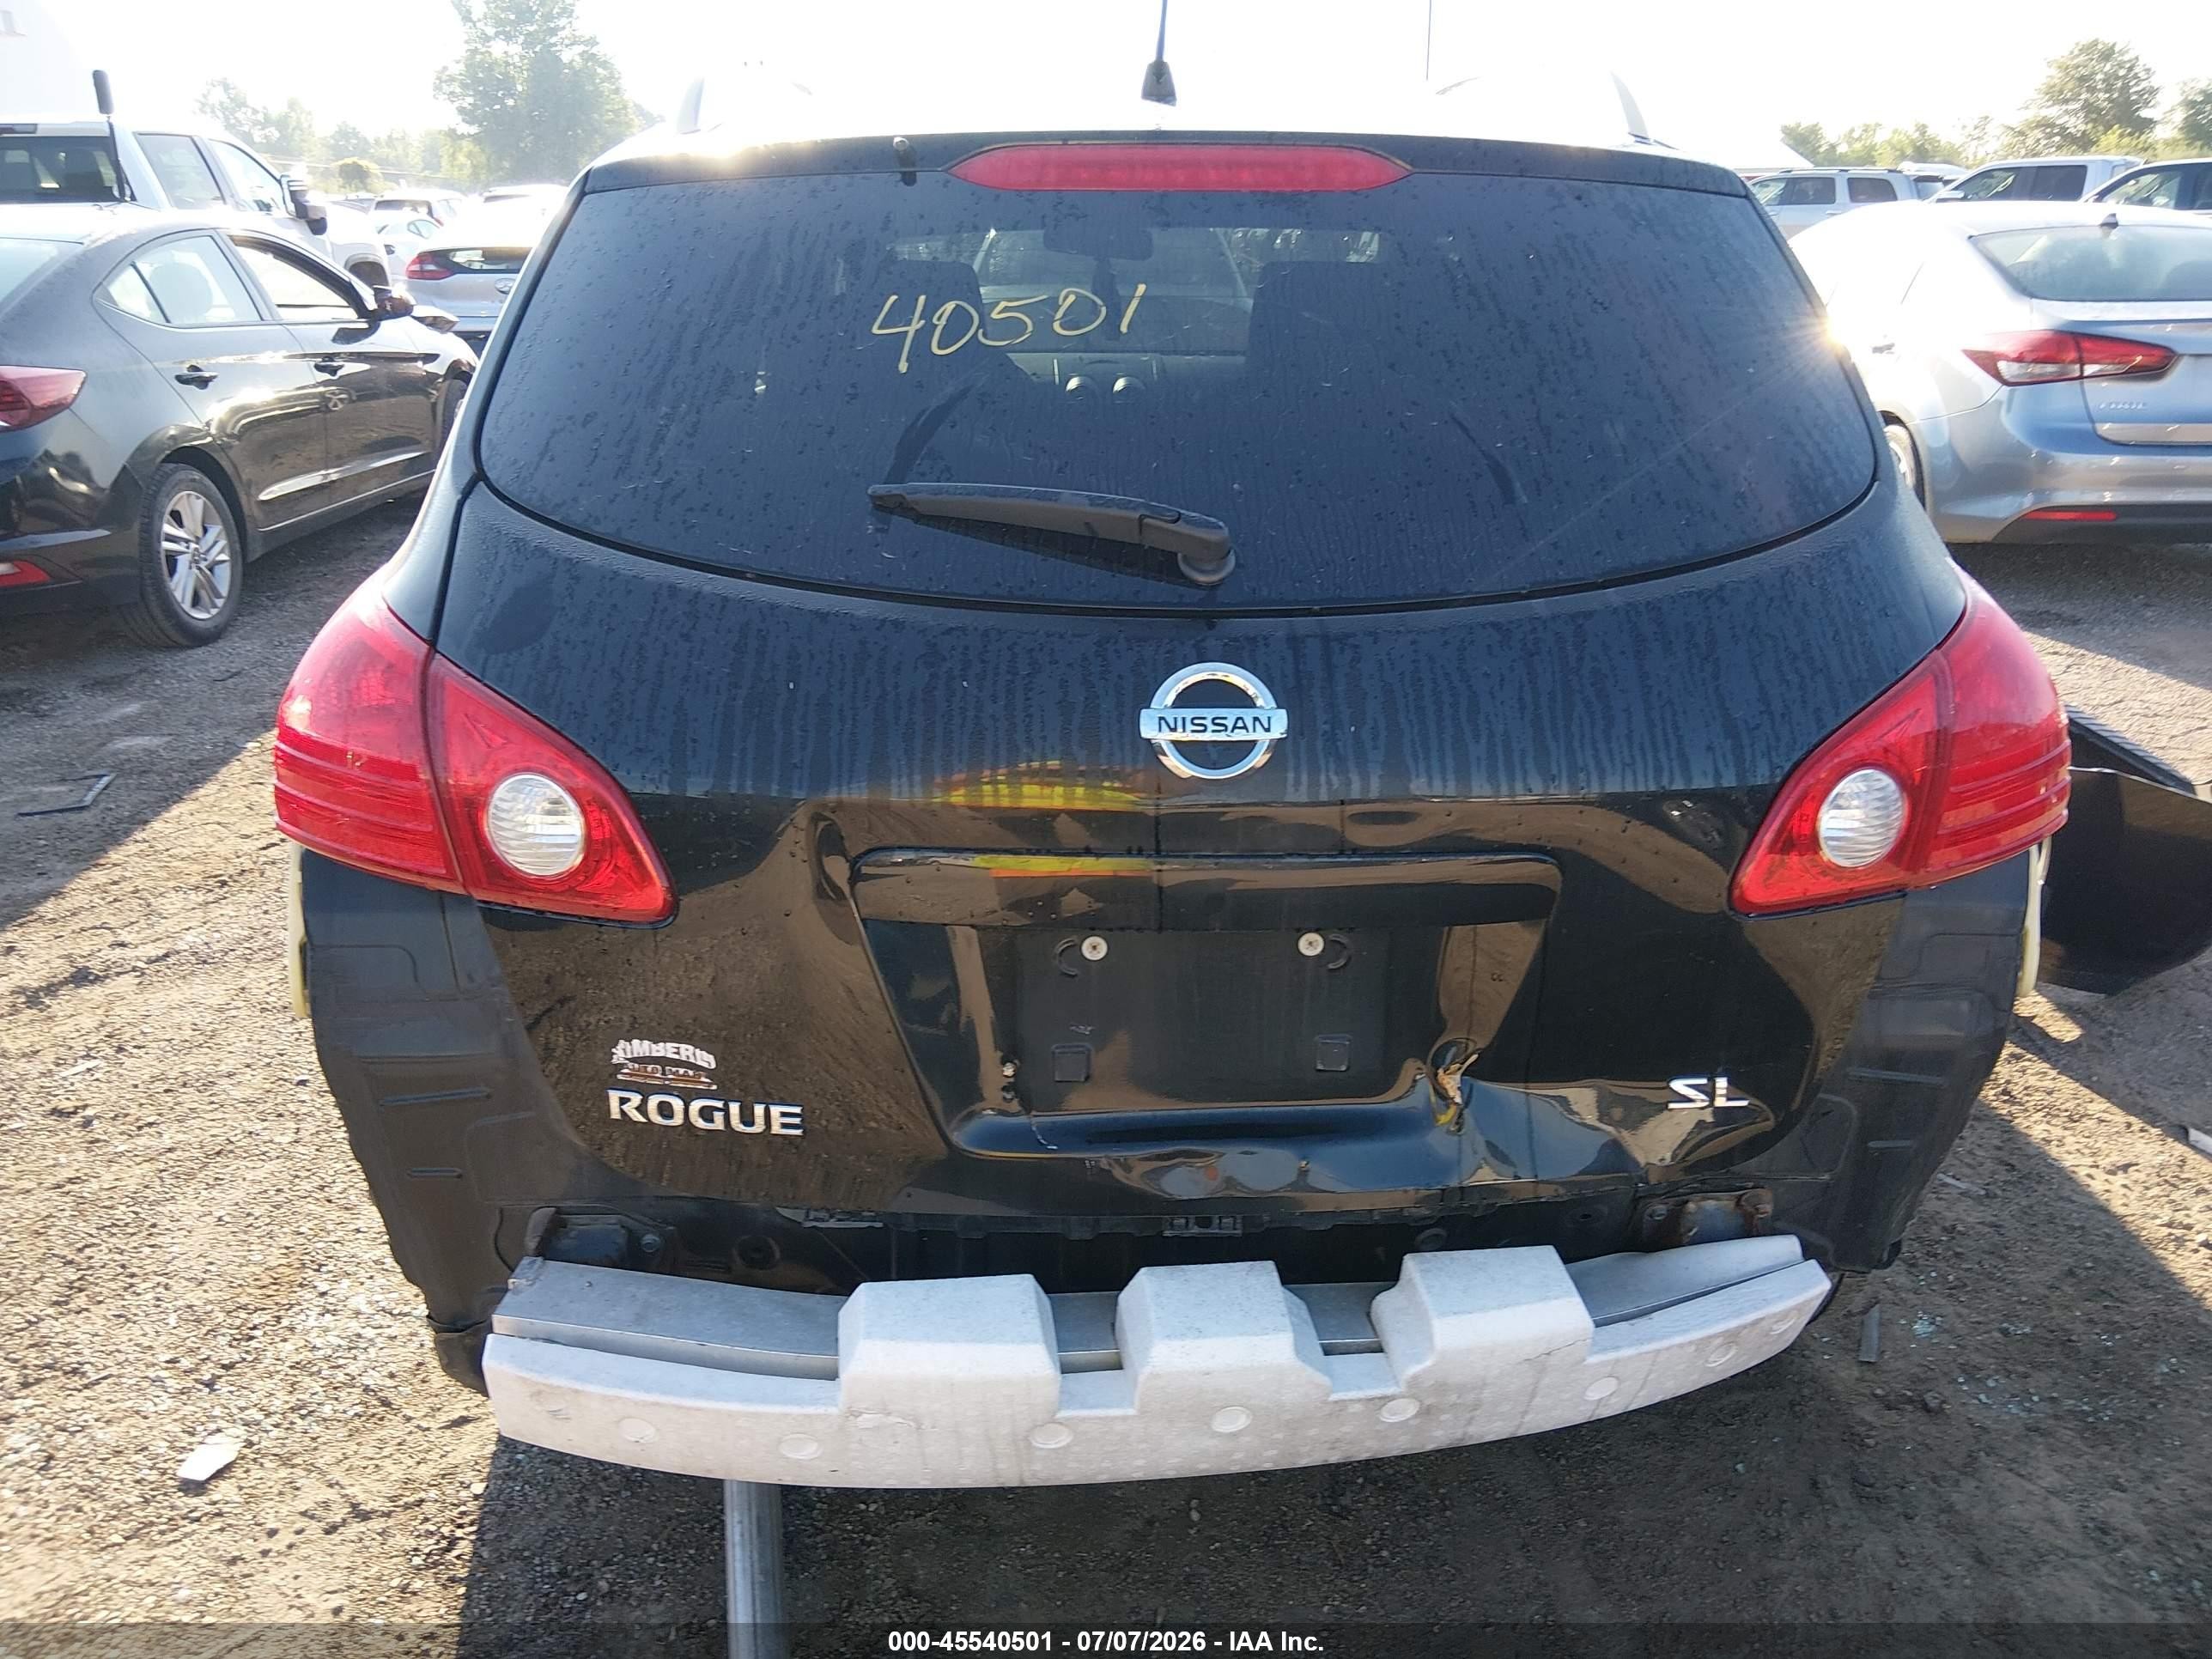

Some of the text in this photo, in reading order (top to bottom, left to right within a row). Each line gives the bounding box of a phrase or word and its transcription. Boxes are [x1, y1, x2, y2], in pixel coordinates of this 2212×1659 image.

[871, 283, 1147, 374] 40501
[1158, 715, 1271, 733] NISSAN
[606, 1088, 805, 1136] ROGUE
[1668, 1076, 1750, 1109] SL
